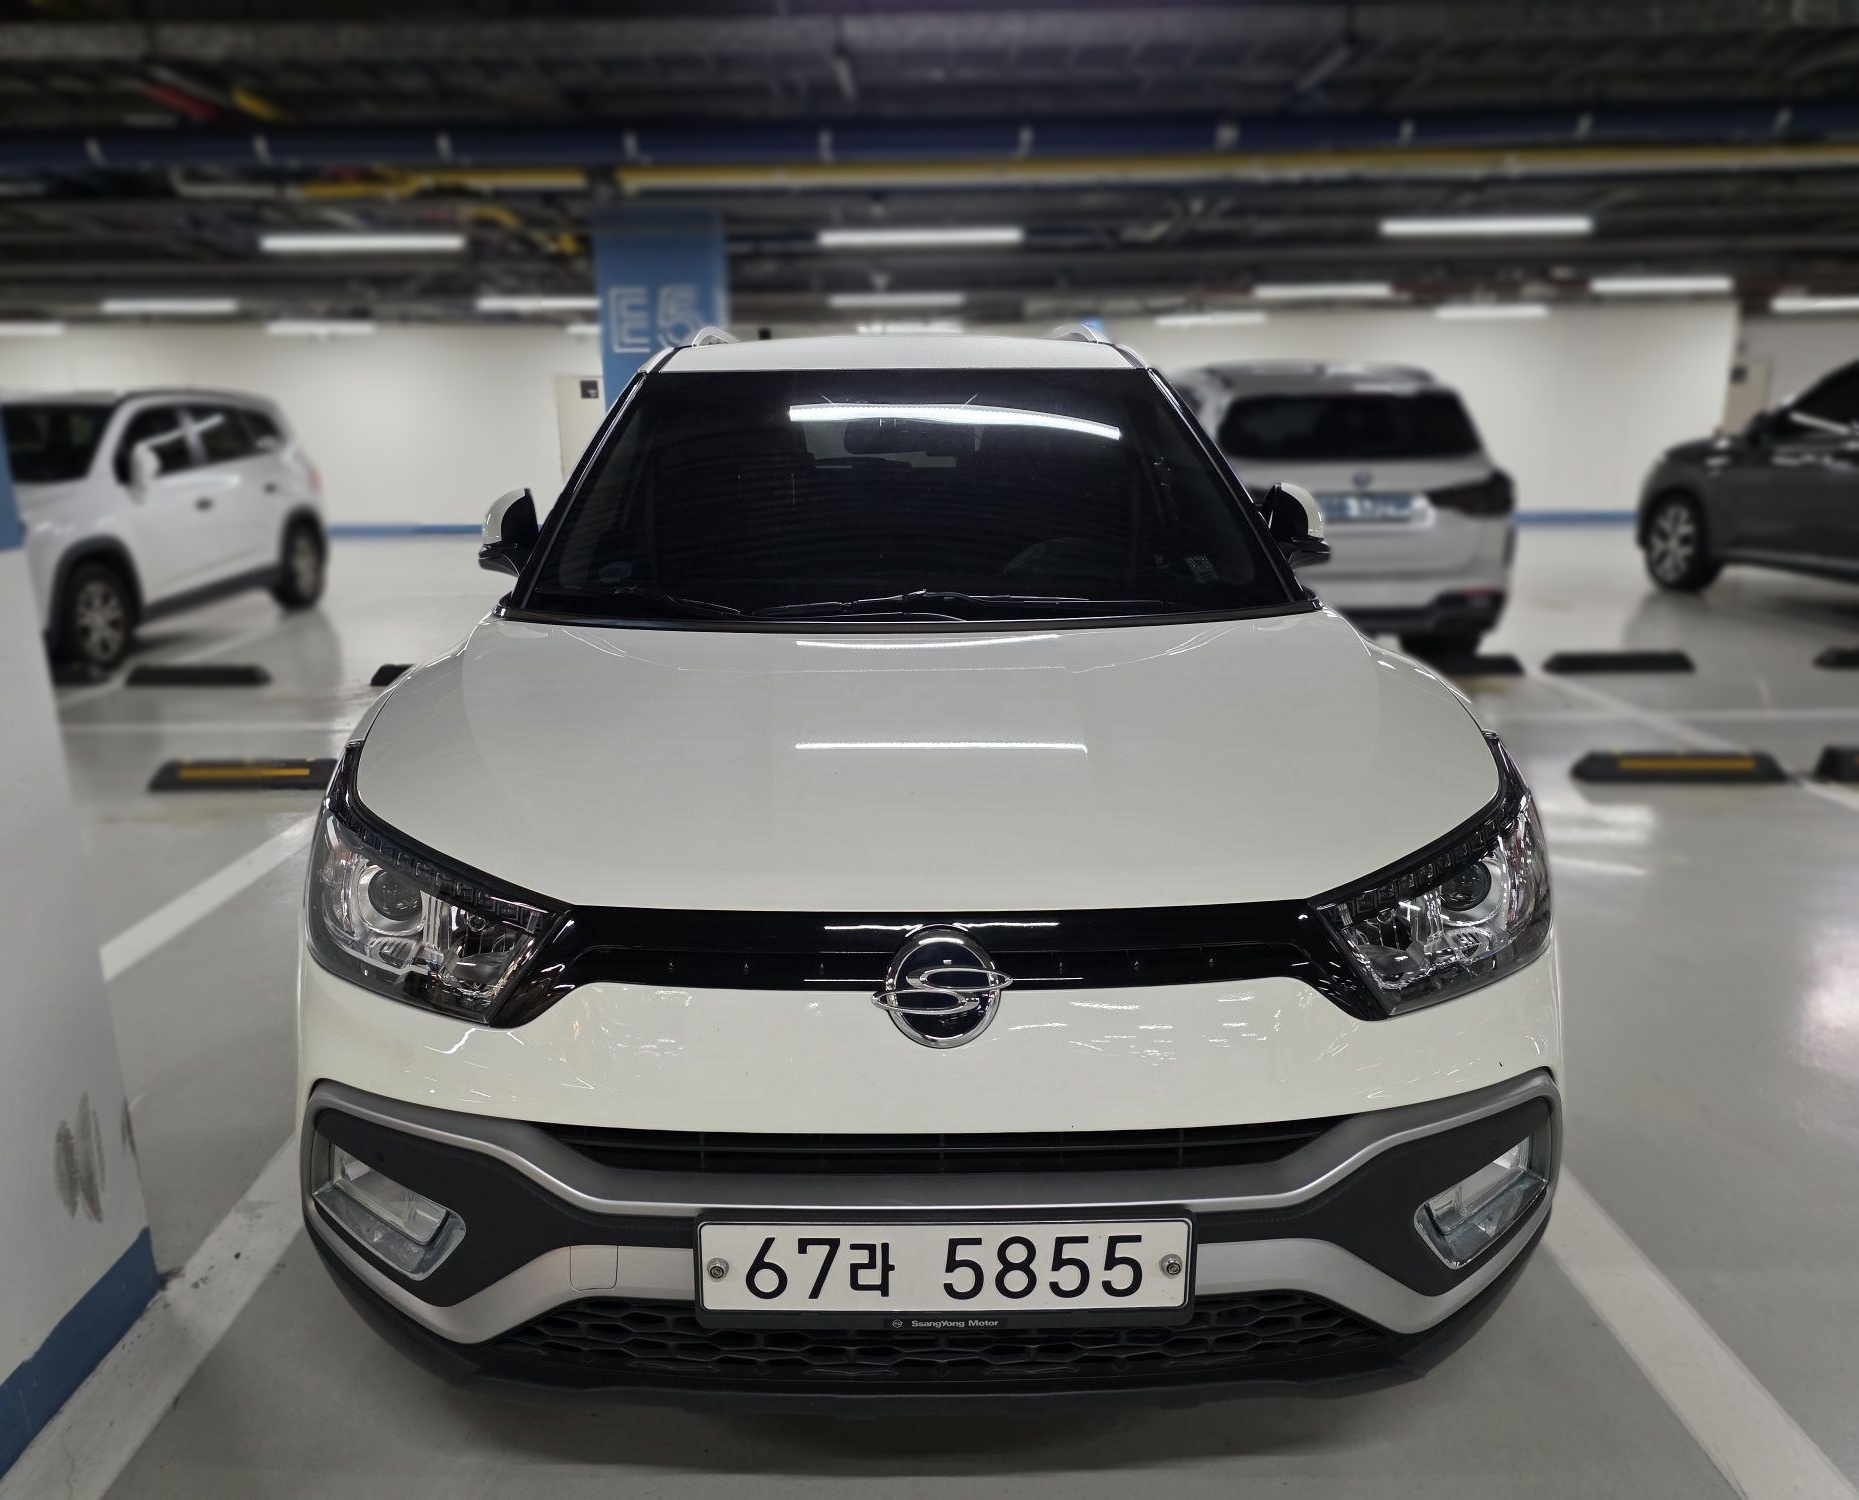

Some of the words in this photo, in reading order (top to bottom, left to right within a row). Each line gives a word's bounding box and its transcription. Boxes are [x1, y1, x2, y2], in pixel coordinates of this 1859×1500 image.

[609, 287, 704, 352] E5
[745, 1236, 896, 1300] 67라
[943, 1234, 1143, 1300] 5855
[911, 1320, 965, 1328] SsangYong
[968, 1319, 999, 1327] Motor
